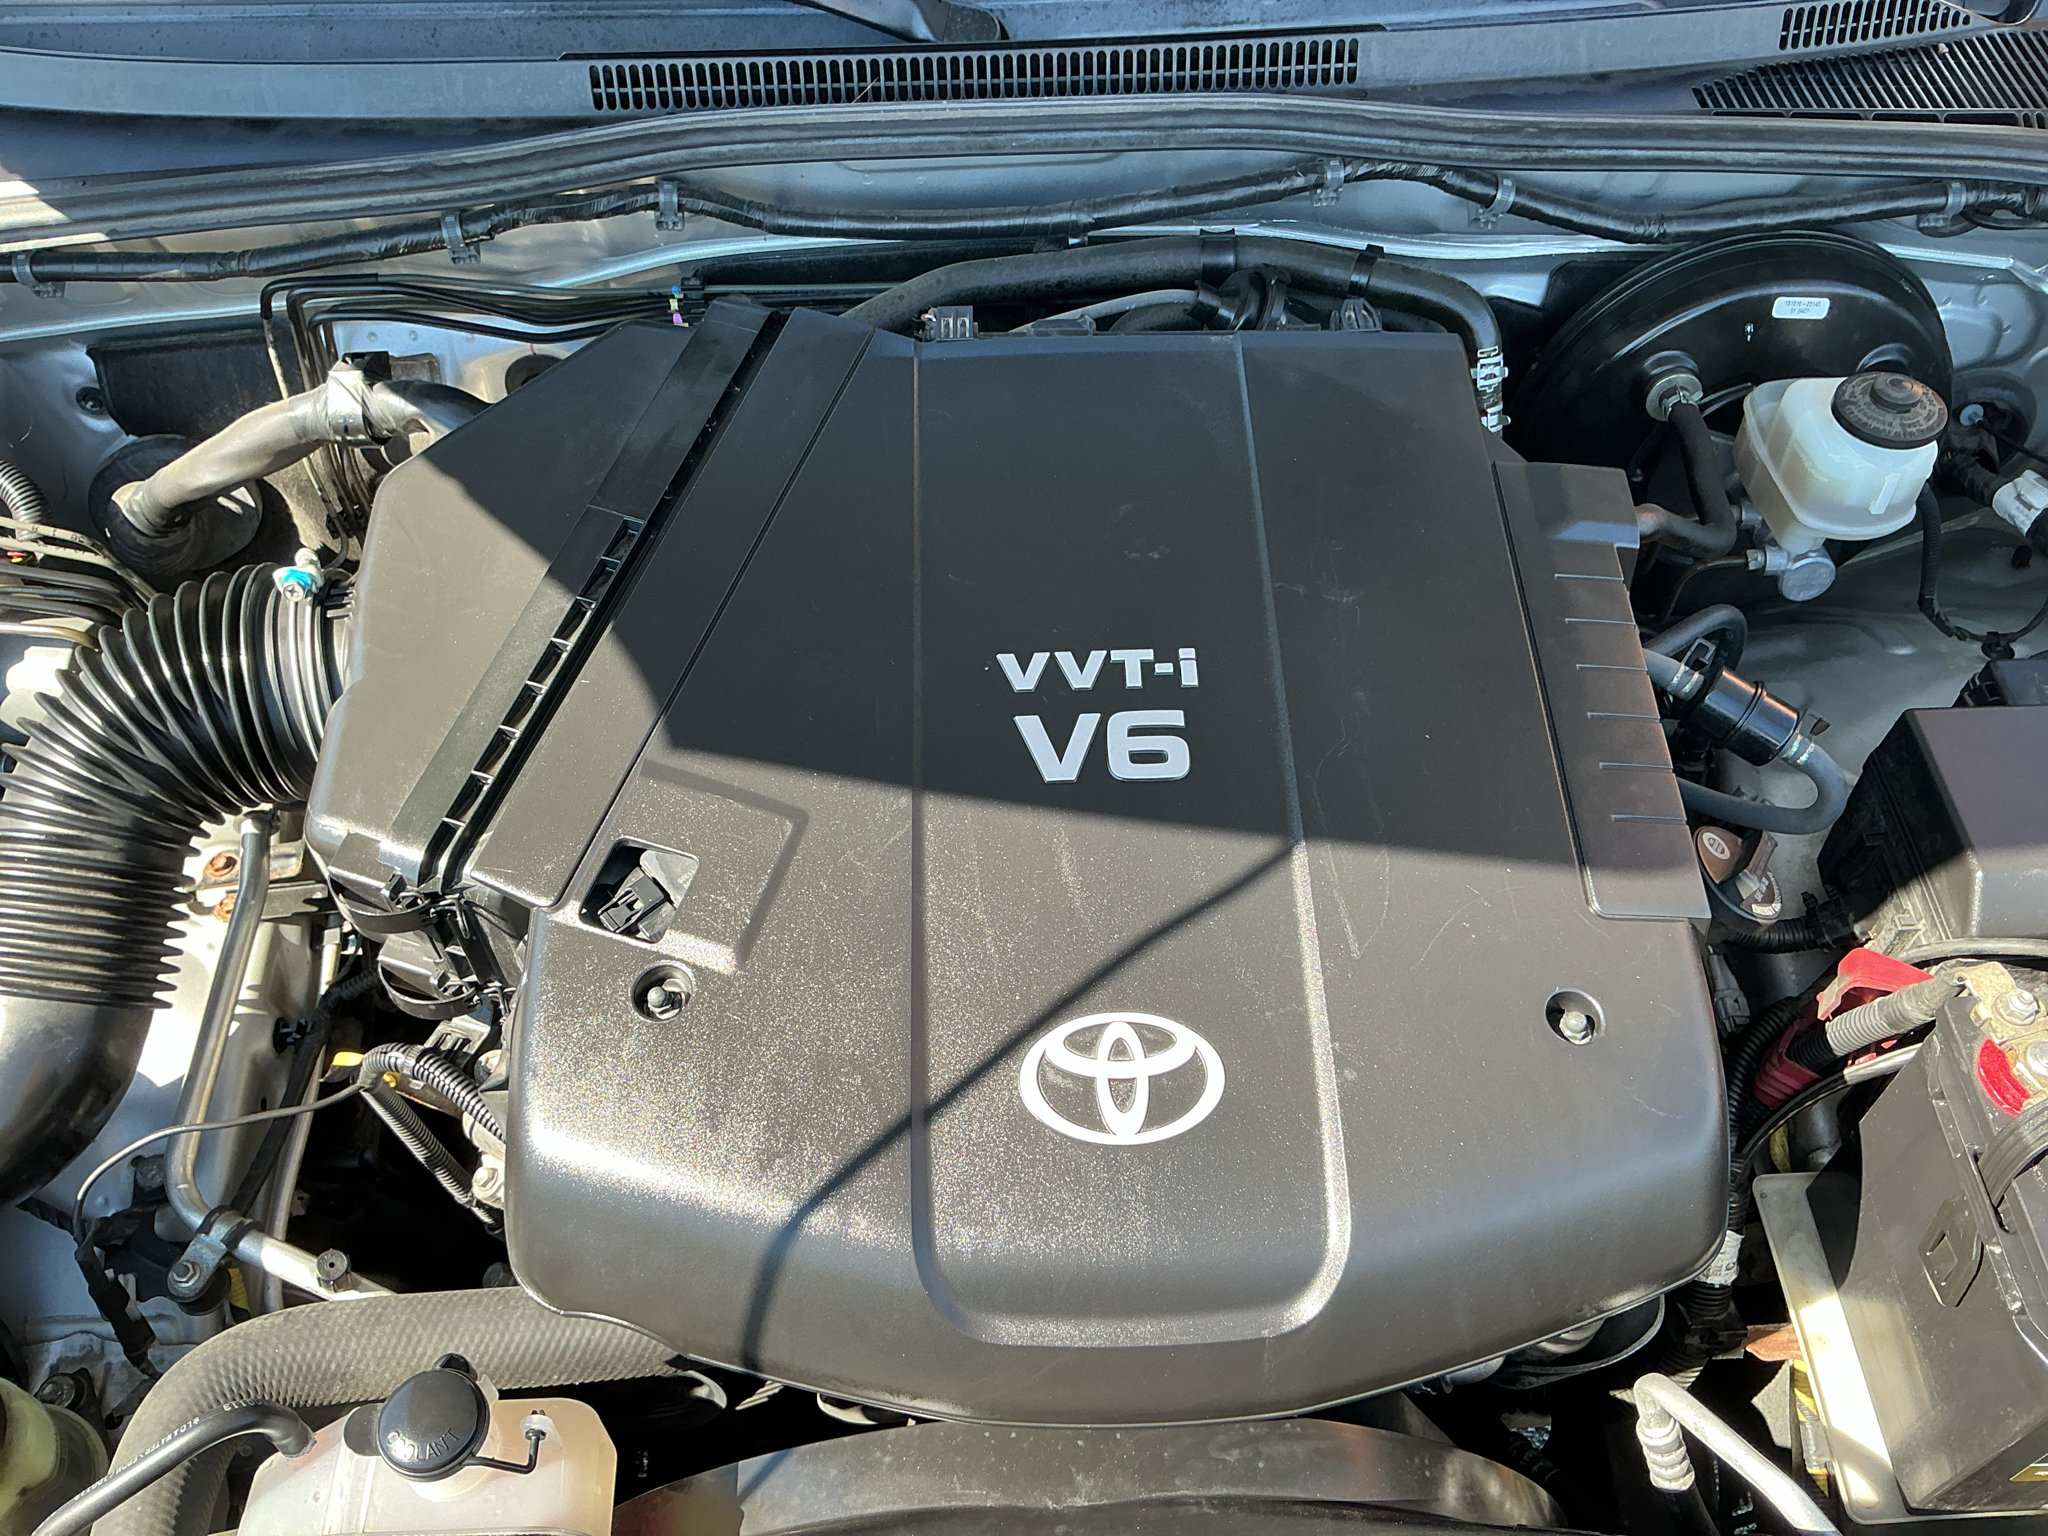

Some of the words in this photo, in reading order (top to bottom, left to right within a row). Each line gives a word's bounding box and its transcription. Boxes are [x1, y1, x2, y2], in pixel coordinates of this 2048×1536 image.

[996, 648, 1199, 693] VVT-i
[1013, 710, 1191, 783] V6
[387, 1427, 460, 1462] COOLANT
